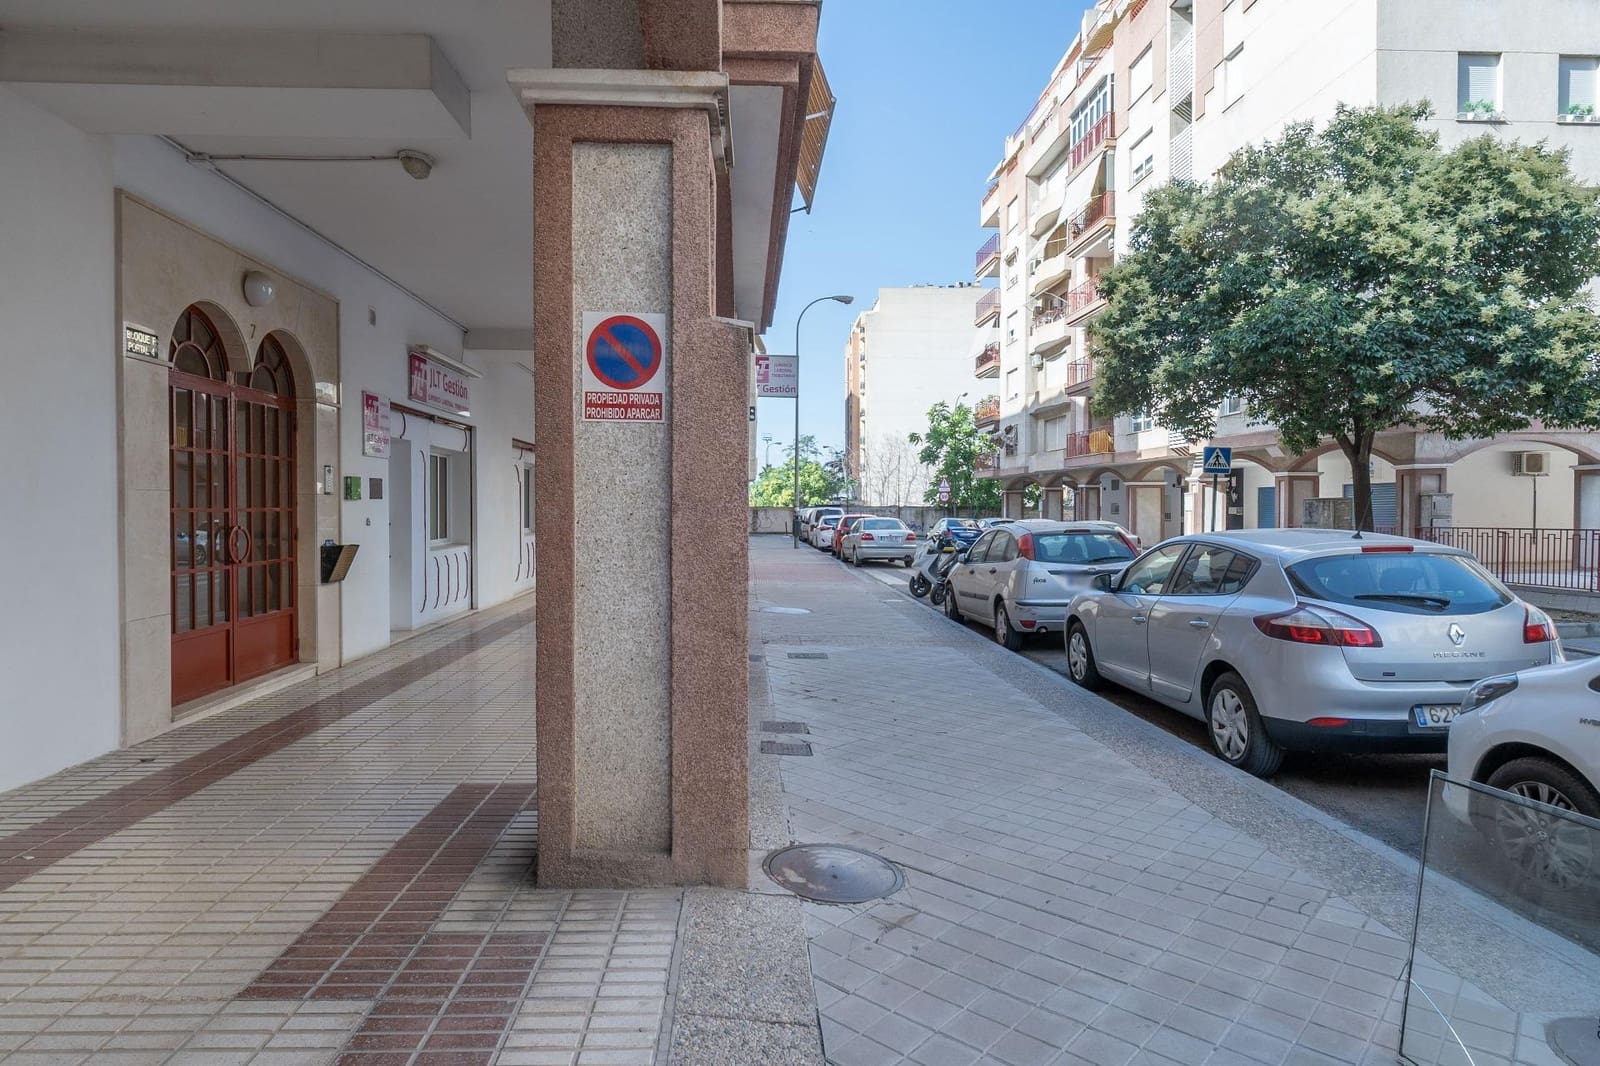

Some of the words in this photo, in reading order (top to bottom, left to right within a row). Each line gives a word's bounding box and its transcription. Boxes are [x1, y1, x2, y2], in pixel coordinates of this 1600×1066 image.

[126, 330, 151, 345] BLOQUE
[127, 341, 151, 356] PORTAL
[429, 368, 441, 388] JLT
[443, 374, 468, 400] Gestión
[762, 384, 796, 393] Gestión
[587, 393, 628, 404] PROPIEDAD
[629, 394, 660, 404] PRIVADA
[586, 407, 625, 418] PROHIBIDO
[627, 408, 660, 419] APARCAR
[1432, 651, 1486, 659] MEGANE
